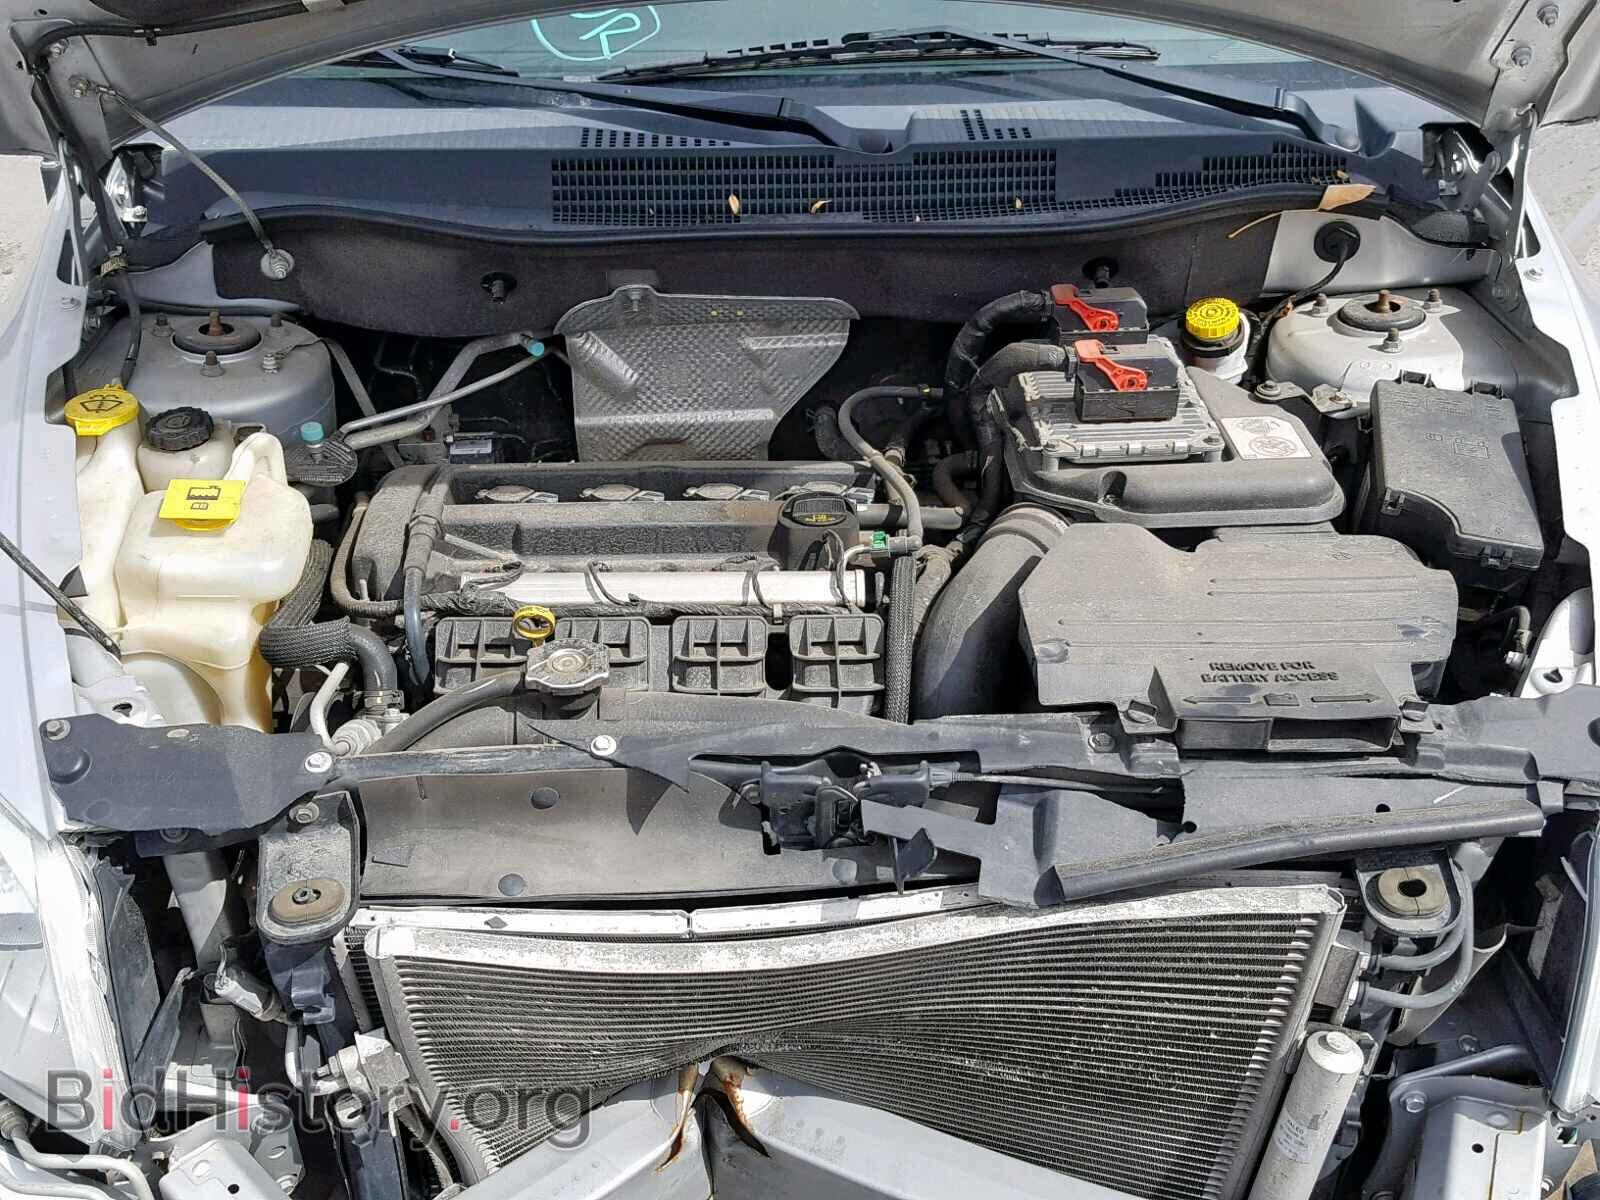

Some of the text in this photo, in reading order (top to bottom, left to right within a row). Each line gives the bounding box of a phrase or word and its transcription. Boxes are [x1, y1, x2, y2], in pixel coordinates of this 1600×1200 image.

[1208, 660, 1316, 672] REMOVE FOR
[1200, 671, 1339, 683] BATTERY ACCESS
